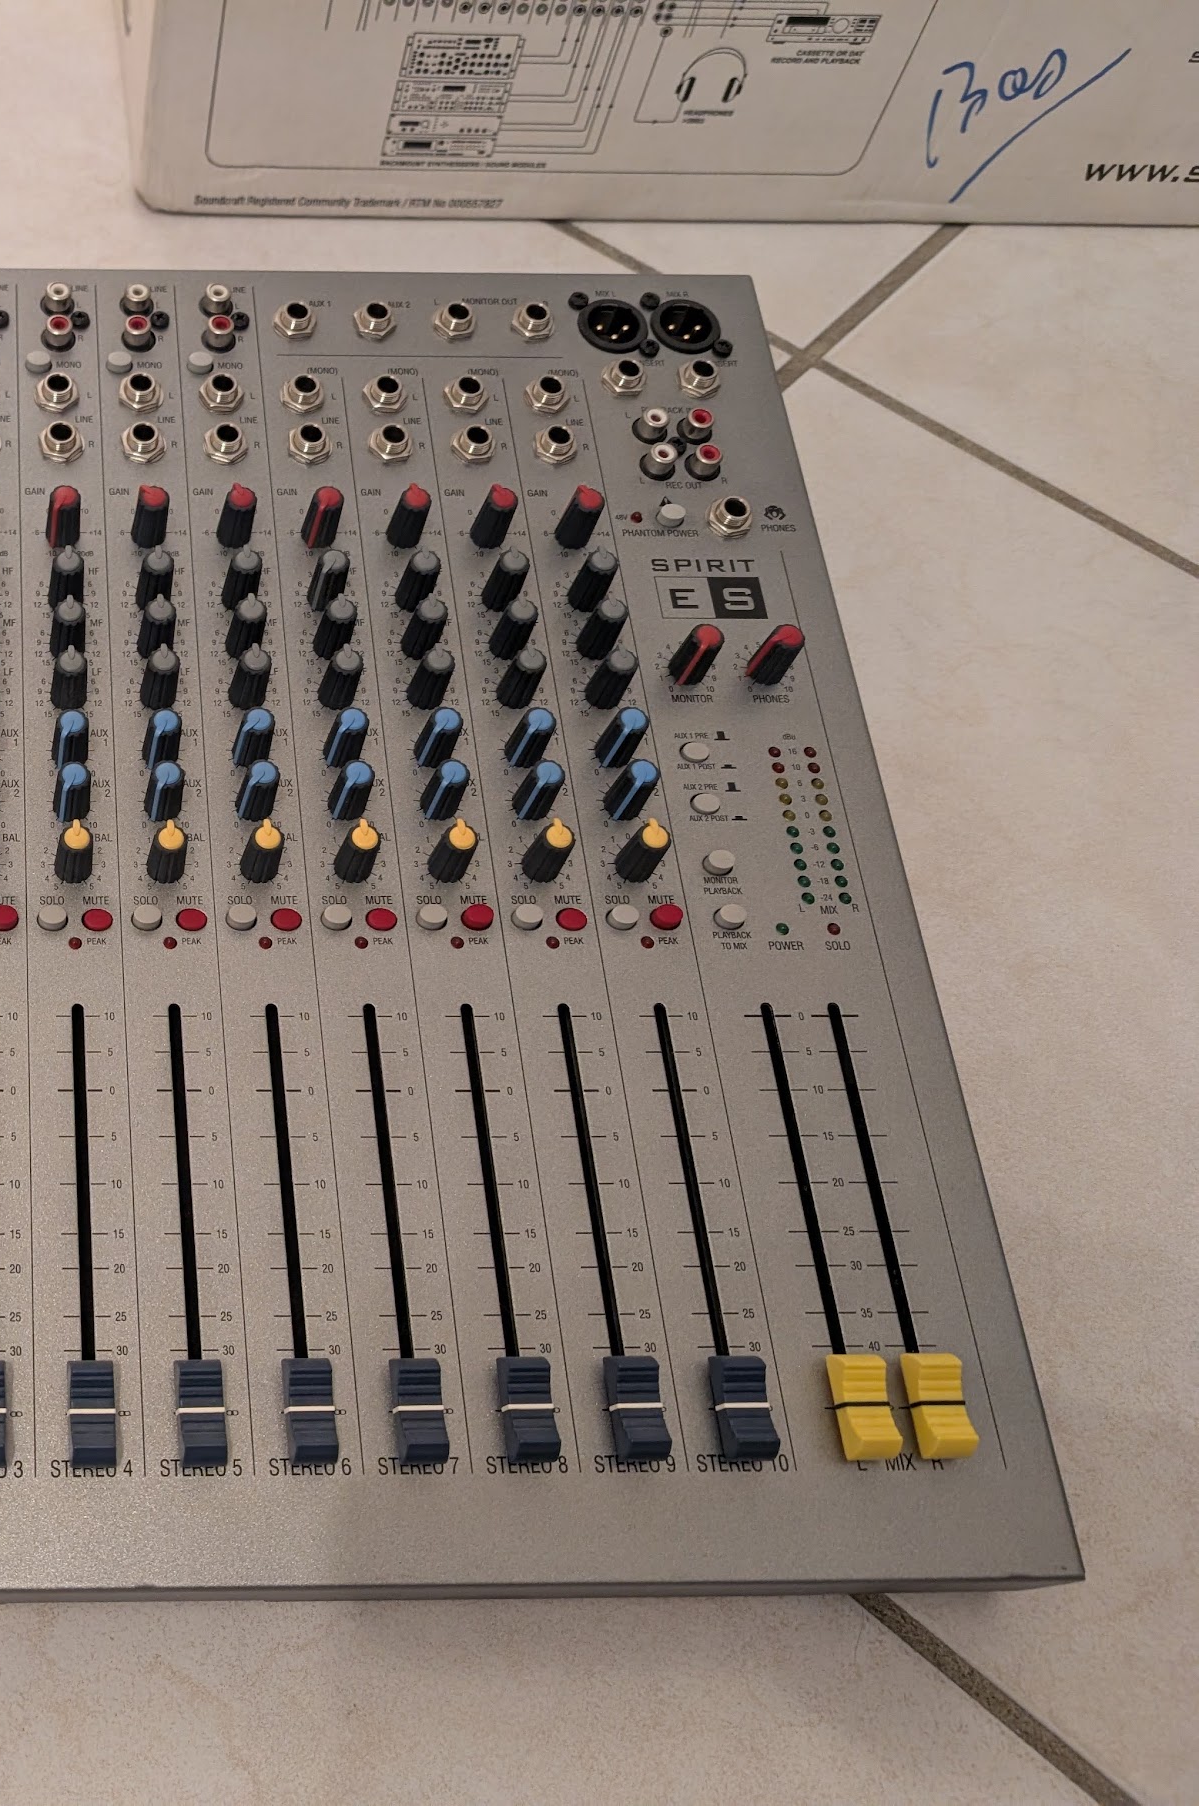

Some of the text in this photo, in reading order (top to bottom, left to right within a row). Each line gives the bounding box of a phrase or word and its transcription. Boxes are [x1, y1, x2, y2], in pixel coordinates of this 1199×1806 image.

[194, 195, 245, 206] Soundcraft
[137, 361, 163, 369] MONO
[218, 362, 243, 370] MONO
[24, 487, 45, 495] GAIN
[277, 488, 297, 496] GAIN
[444, 488, 465, 496] GAIN
[527, 489, 548, 497] GAIN
[761, 524, 796, 532] PHONES
[622, 529, 699, 538] PHANTOM POWER
[651, 558, 755, 573] SPIRIT
[671, 694, 713, 703] MONITOR
[753, 694, 790, 703] PHONES
[2, 834, 20, 842] BAL
[703, 877, 738, 885] MONITOR
[704, 887, 743, 895] PLAYBACK
[39, 895, 65, 905] SOLO
[82, 895, 109, 905] MUTE
[133, 895, 159, 905] SOLO
[176, 895, 203, 905] MUTE
[227, 895, 253, 905] SOLO
[270, 895, 298, 905] MUTE
[321, 895, 347, 905] SOLO
[365, 895, 393, 905] MUTE
[416, 895, 442, 905] SOLO
[460, 895, 487, 905] MUTE
[511, 895, 537, 905] SOLO
[554, 895, 582, 905] MUTE
[605, 895, 630, 905] SOLO
[648, 895, 675, 905] MUTE
[820, 906, 838, 914] MIX
[713, 931, 752, 939] PLAYBACK
[86, 937, 107, 946] PEAK
[182, 937, 202, 946] PEAK
[277, 937, 297, 946] PEAK
[373, 937, 394, 946] PEAK
[468, 937, 489, 946] PEAK
[564, 937, 584, 946] PEAK
[658, 937, 679, 946] PEAK
[721, 942, 748, 950] TO MIX
[768, 942, 804, 951] POWER
[825, 942, 851, 951] SOLO
[813, 1085, 824, 1094] 10
[823, 1131, 834, 1141] 15
[833, 1178, 844, 1187] 20
[843, 1226, 855, 1236] 25
[850, 1260, 862, 1270] 30
[861, 1308, 873, 1318] 35
[868, 1341, 880, 1351] 40
[232, 1458, 242, 1477] 5
[341, 1457, 352, 1476] 6
[450, 1456, 459, 1475] 7
[558, 1455, 568, 1474] 8
[666, 1454, 676, 1473] 9
[771, 1453, 789, 1472] 10
[13, 1460, 24, 1479] 3
[123, 1459, 133, 1477] 4
